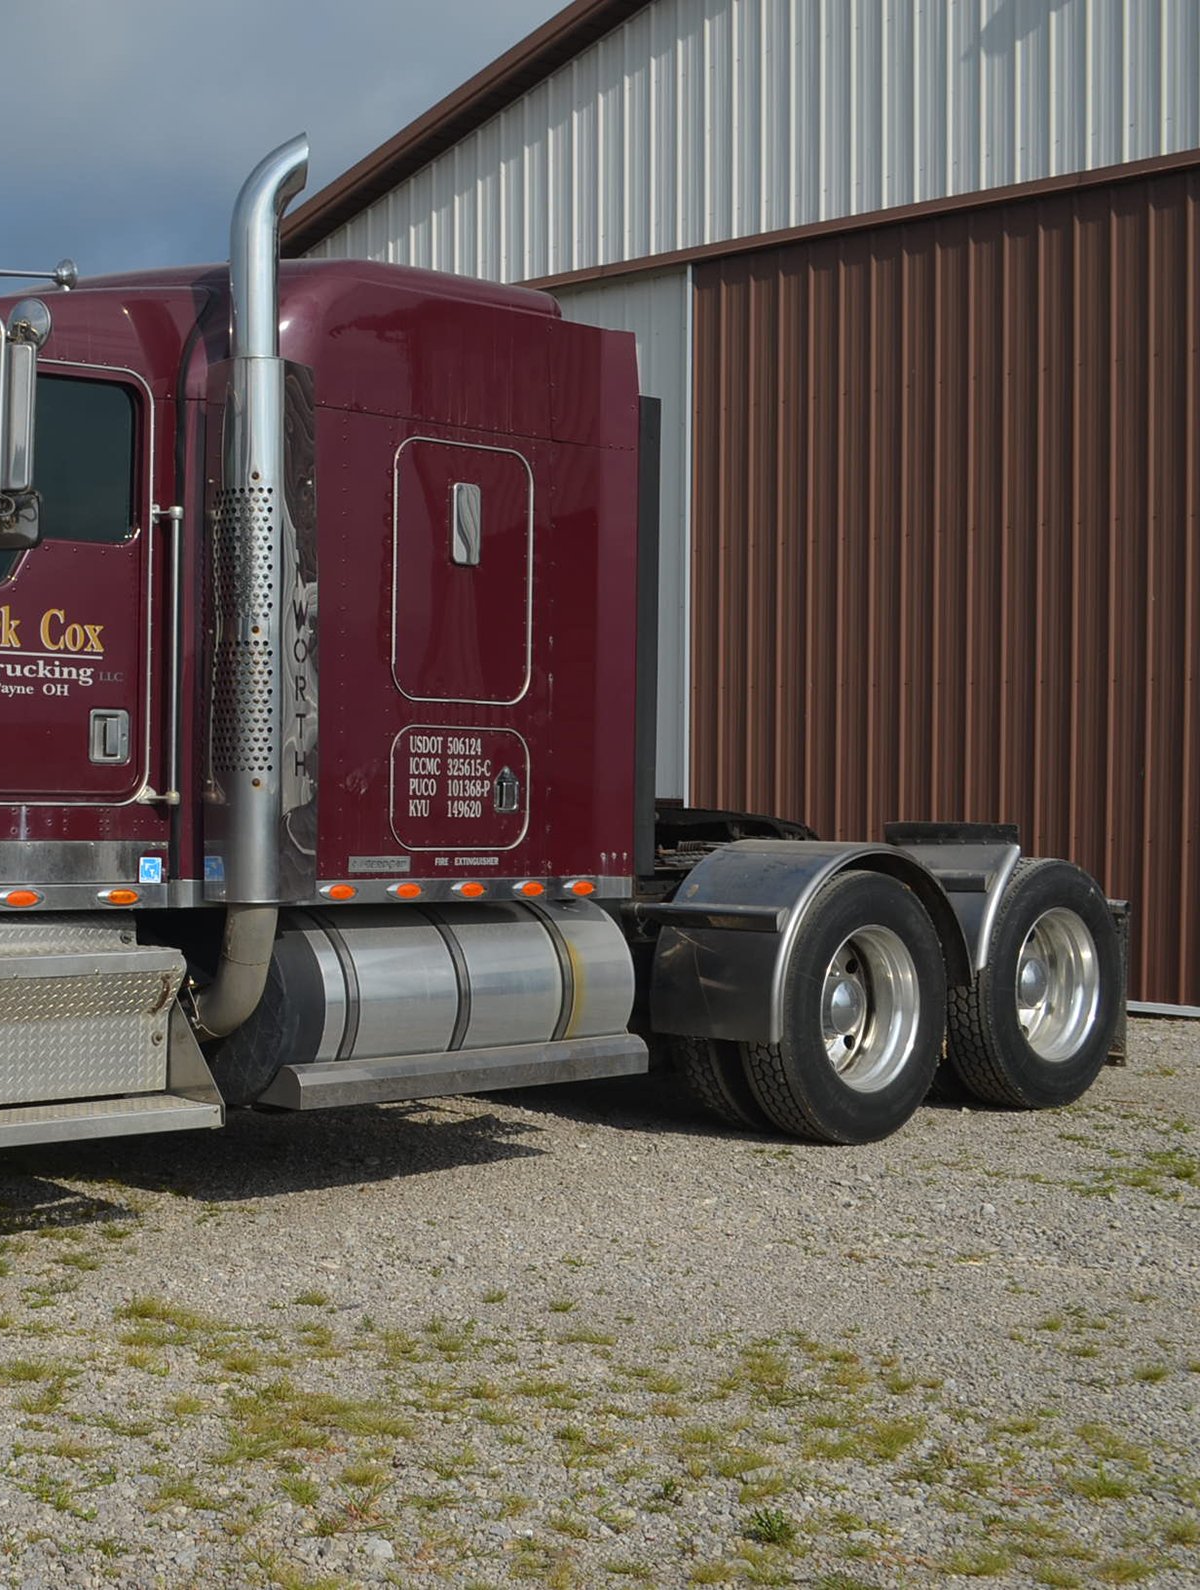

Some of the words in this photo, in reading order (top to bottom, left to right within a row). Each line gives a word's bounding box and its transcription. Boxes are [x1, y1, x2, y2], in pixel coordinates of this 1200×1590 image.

[40, 608, 104, 653] Cox
[42, 683, 70, 697] OH
[409, 735, 444, 754] USDOT
[447, 737, 482, 755] 506124
[409, 757, 441, 775] ICCMC
[447, 758, 492, 777] 325615-C
[409, 778, 437, 796] PUCO
[447, 779, 491, 797] 101368-P
[408, 799, 430, 817] KYU
[447, 800, 482, 818] 149620
[434, 857, 449, 866] FIRE
[454, 857, 499, 866] EXTINGUISHER
